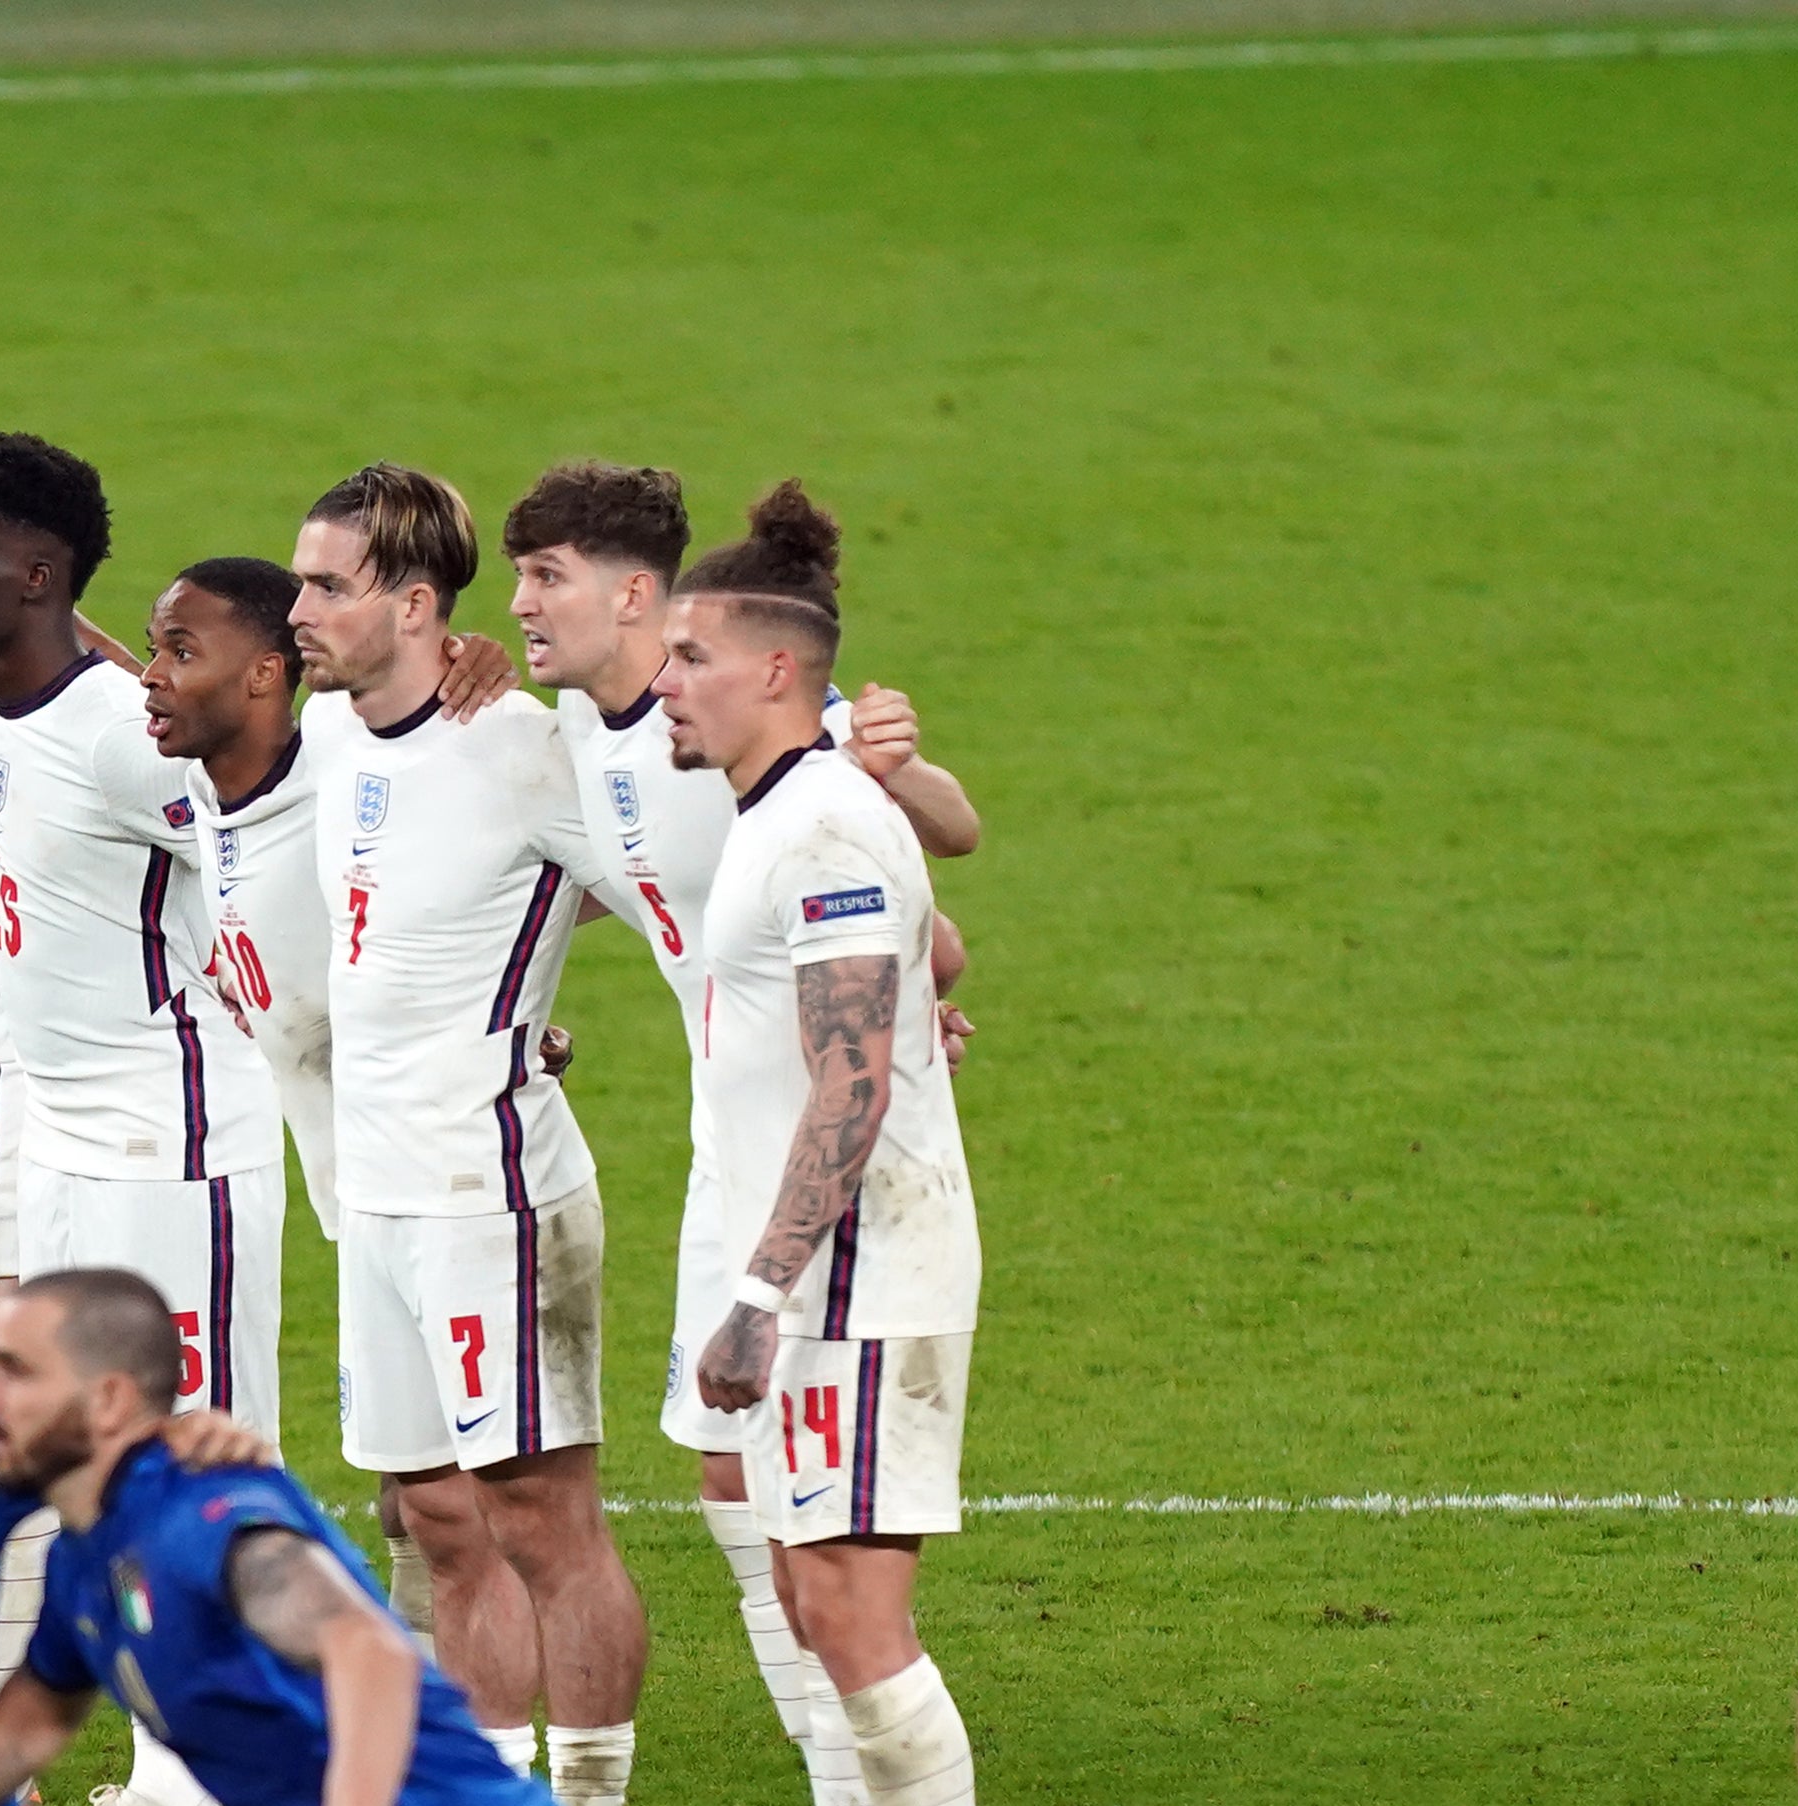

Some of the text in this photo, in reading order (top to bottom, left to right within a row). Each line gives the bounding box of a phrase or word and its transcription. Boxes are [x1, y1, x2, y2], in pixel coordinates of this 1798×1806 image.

[348, 886, 370, 966] 7
[638, 881, 684, 958] 5
[824, 892, 883, 914] RESPECT
[219, 928, 273, 1012] 10
[170, 1310, 205, 1397] 5
[449, 1313, 487, 1399] 7
[781, 1384, 842, 1474] 14
